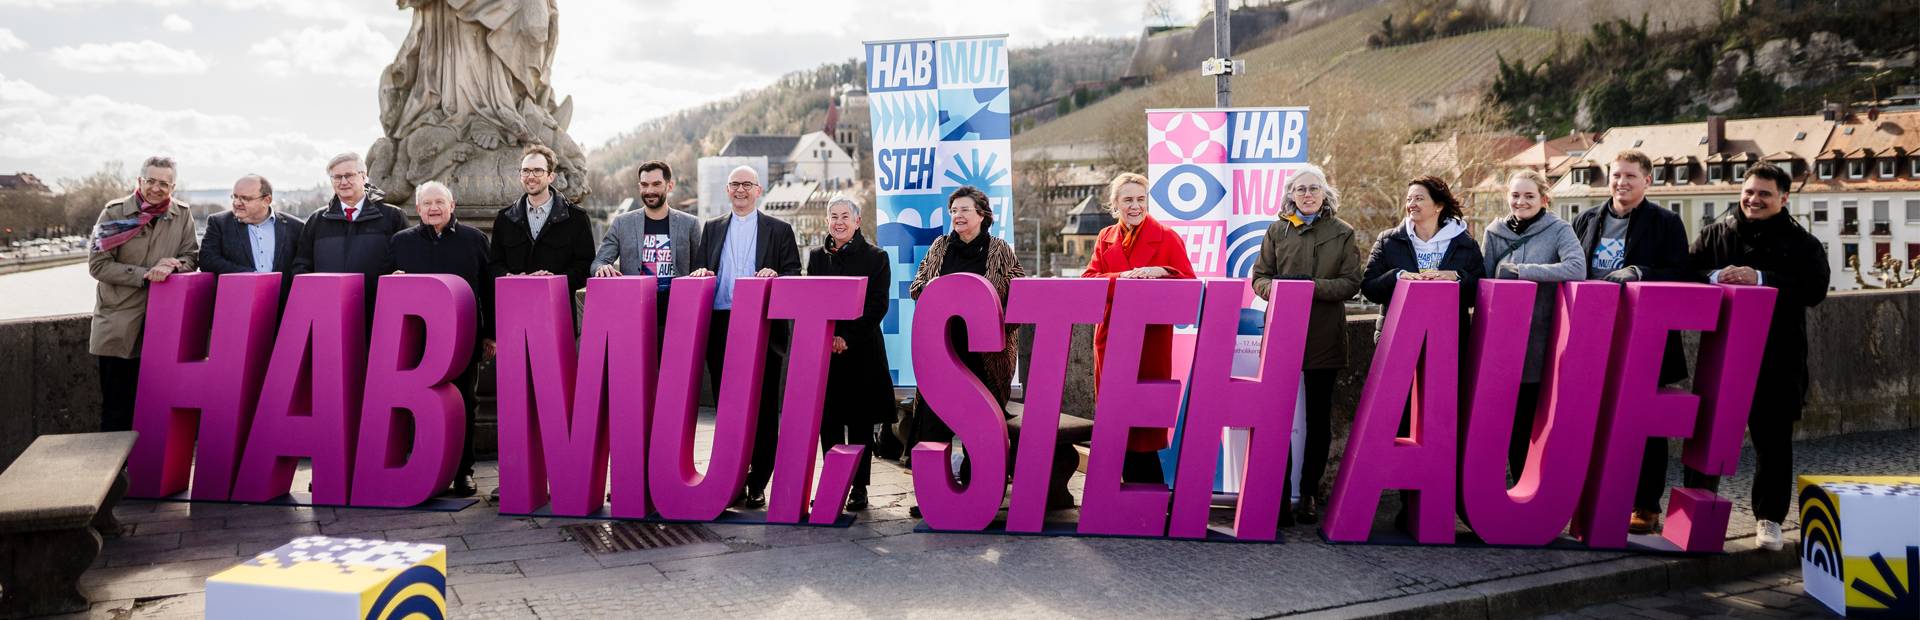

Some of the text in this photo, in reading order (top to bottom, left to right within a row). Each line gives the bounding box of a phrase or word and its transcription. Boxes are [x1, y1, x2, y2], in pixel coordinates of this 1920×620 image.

[871, 39, 1005, 89] HAB MUT,
[1230, 111, 1303, 159] HAB
[878, 147, 937, 192] STEH
[642, 249, 672, 262] UT, STE
[643, 235, 656, 248] AB
[127, 272, 1779, 553] HAB MUT, STEH AUF!
